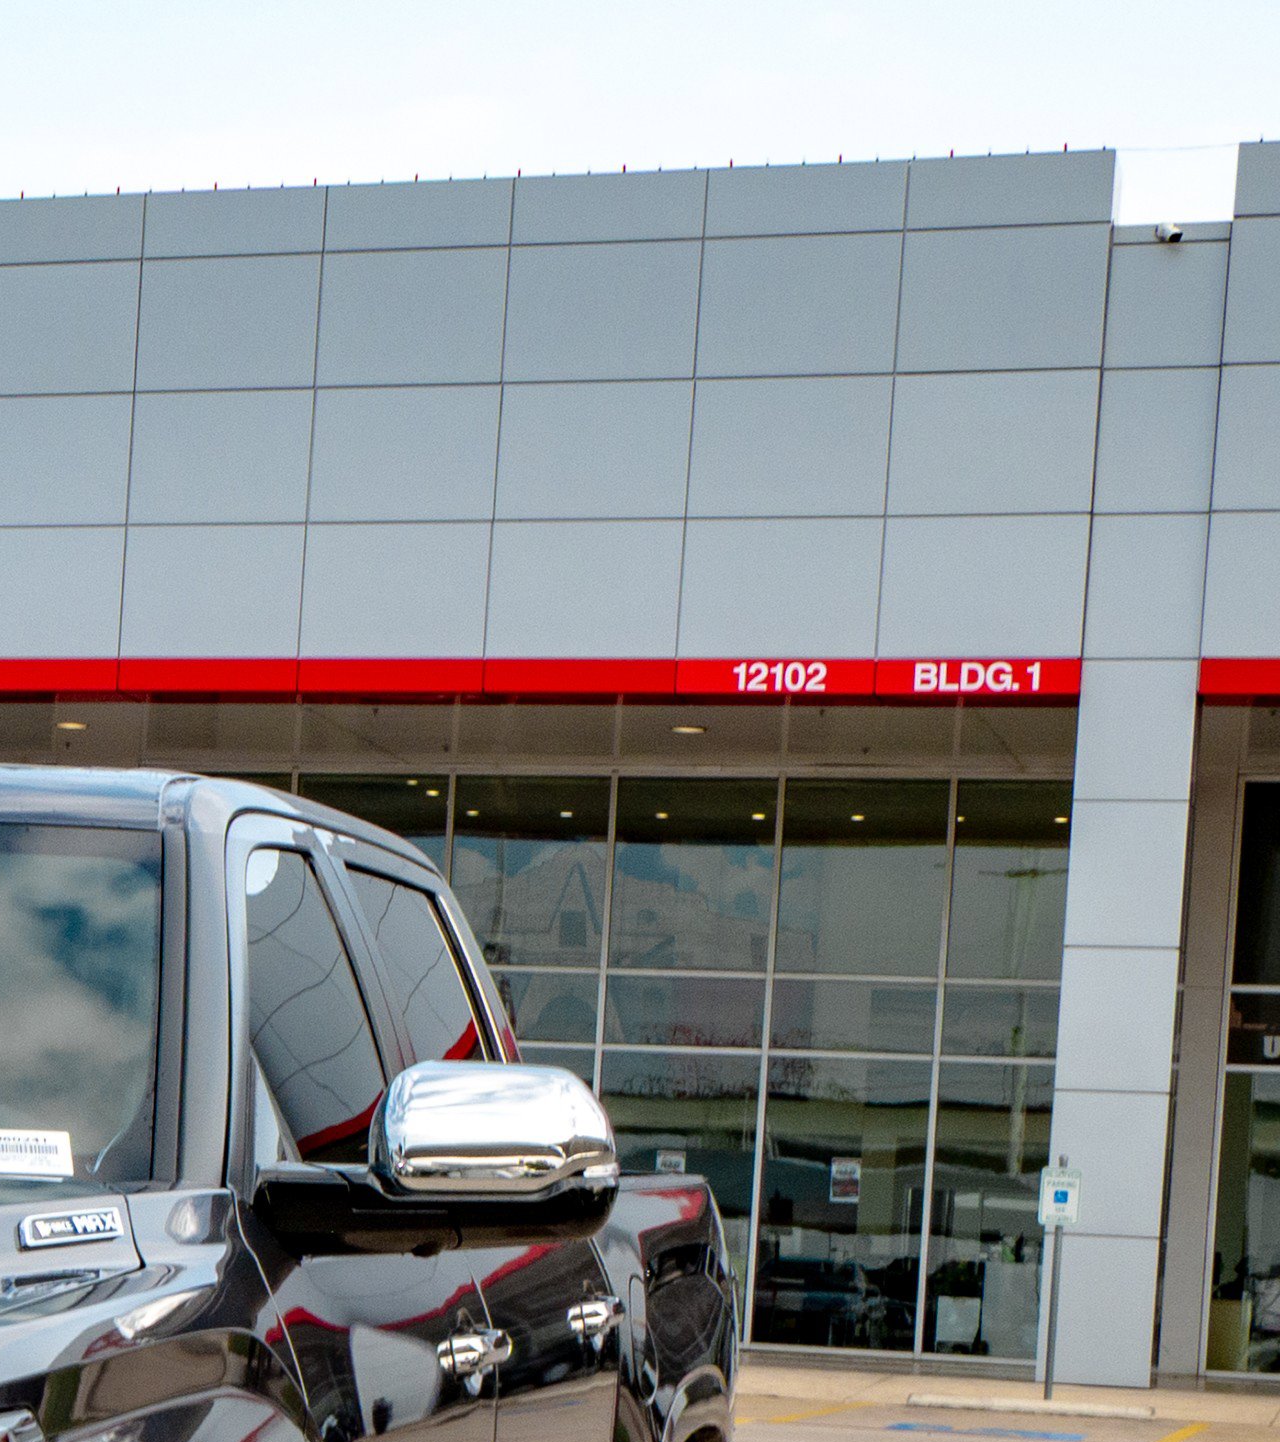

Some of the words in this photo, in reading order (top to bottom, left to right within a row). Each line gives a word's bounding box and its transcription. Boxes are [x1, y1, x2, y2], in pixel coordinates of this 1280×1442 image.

[733, 661, 828, 693] 12102
[913, 661, 1020, 693] BLDG.
[1026, 661, 1042, 692] 1
[71, 1211, 117, 1234] MAX
